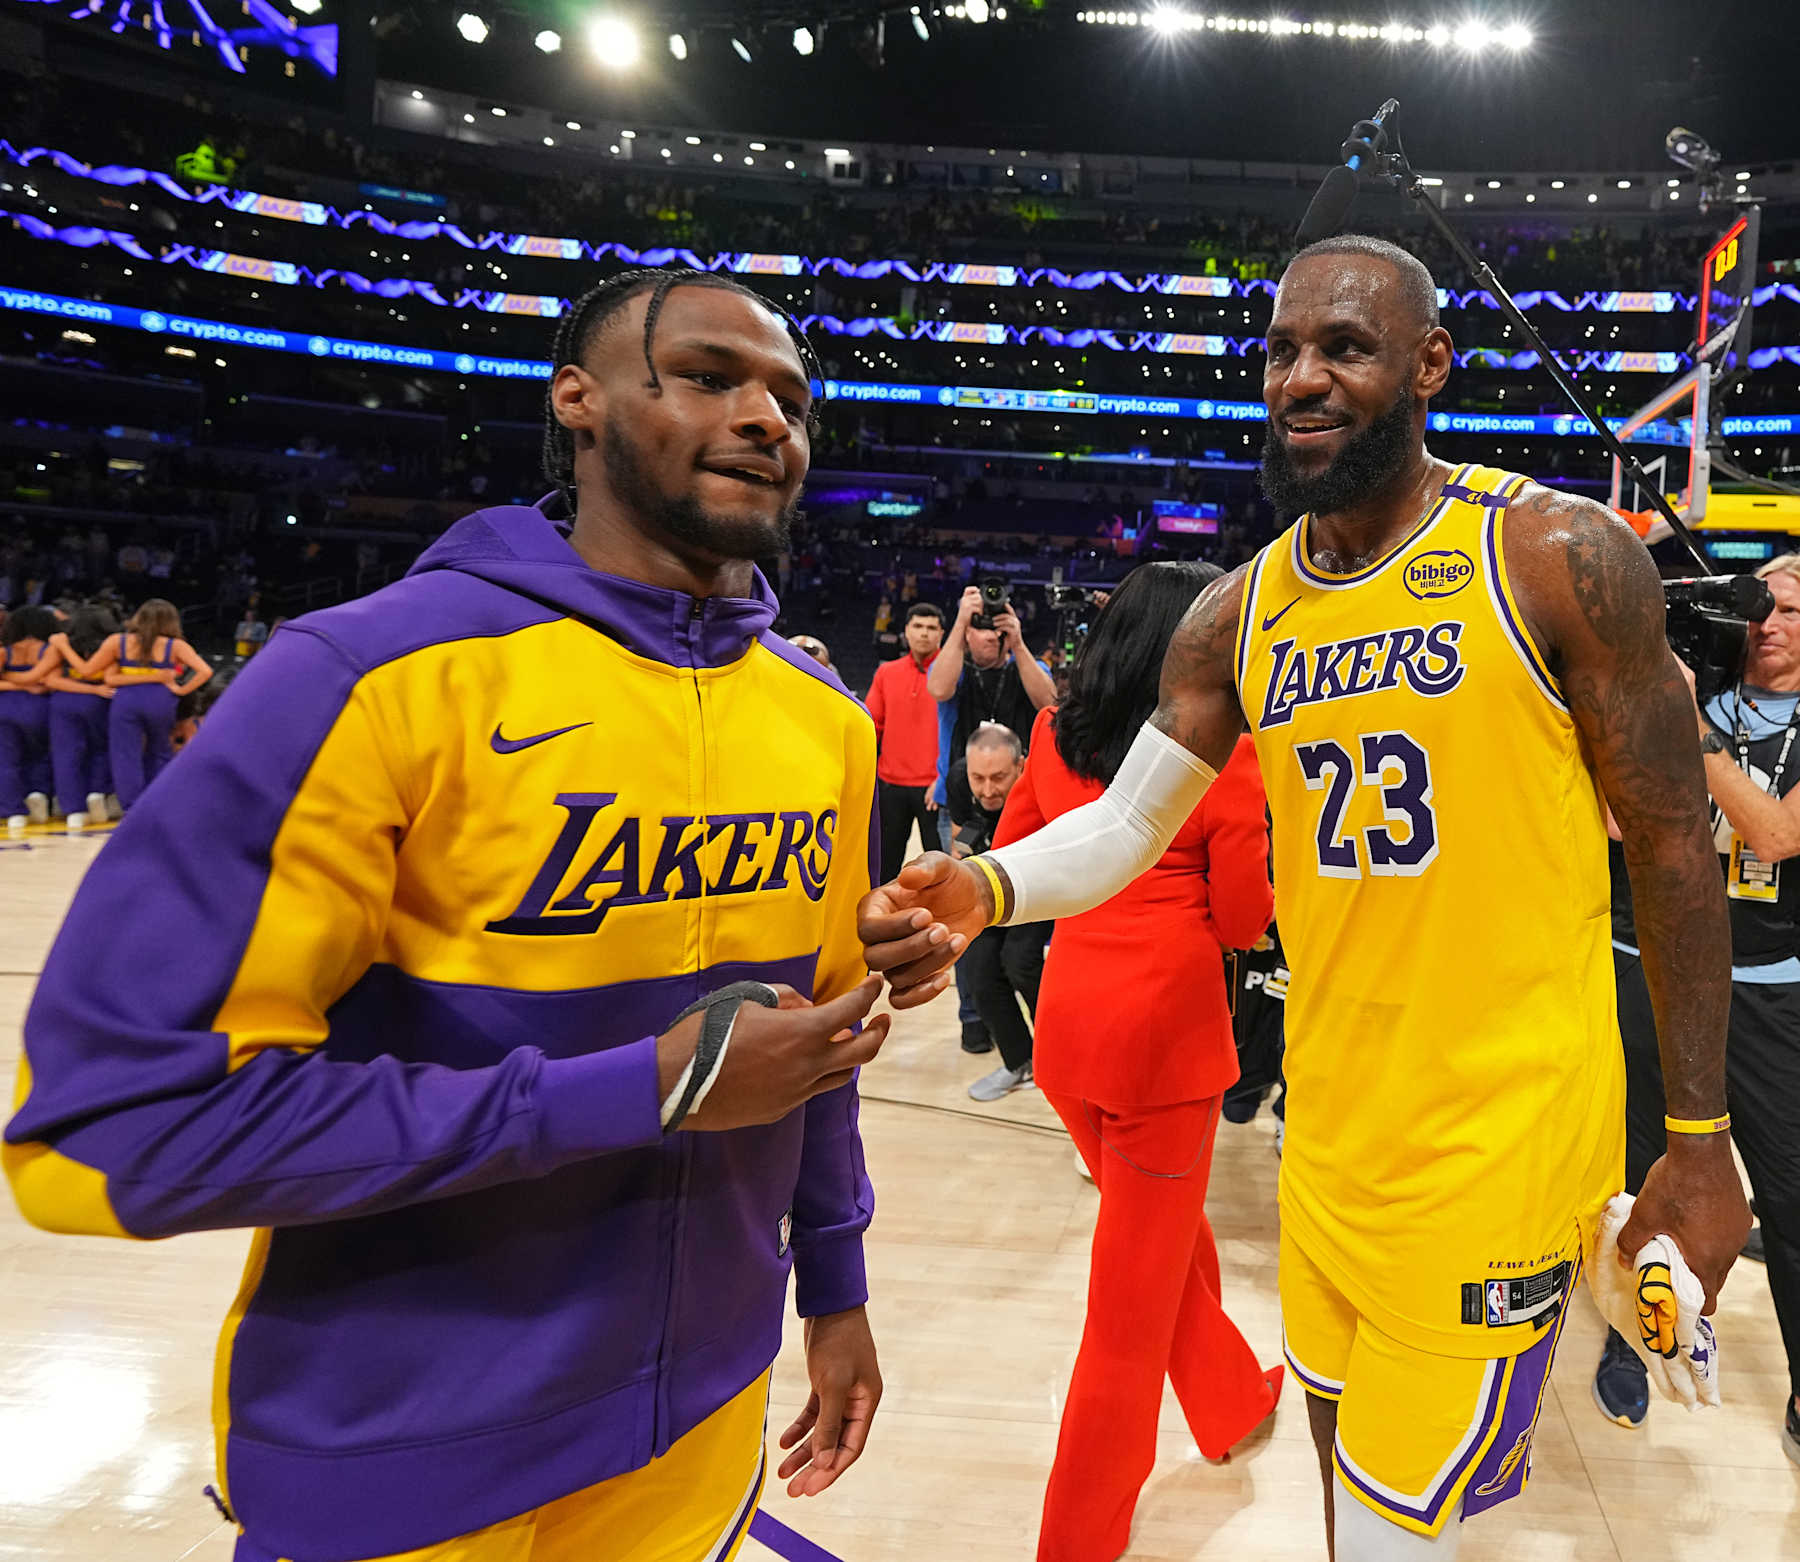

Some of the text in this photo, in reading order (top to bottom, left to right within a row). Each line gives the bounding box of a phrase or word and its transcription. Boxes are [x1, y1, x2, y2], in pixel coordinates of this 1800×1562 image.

[0, 290, 112, 321] ypto.com
[170, 318, 286, 348] crypto.com
[333, 342, 434, 366] crypto.com
[478, 359, 553, 377] crypto.co
[840, 385, 922, 400] crypto.com
[1100, 399, 1180, 414] crypto.com
[1216, 405, 1269, 419] crypto.
[1452, 416, 1535, 432] crypto.com
[1723, 418, 1792, 435] pto.com
[1410, 563, 1470, 582] bibigo
[1259, 620, 1467, 731] LAKERS
[1293, 730, 1439, 880] 23
[482, 793, 839, 935] LAKERS
